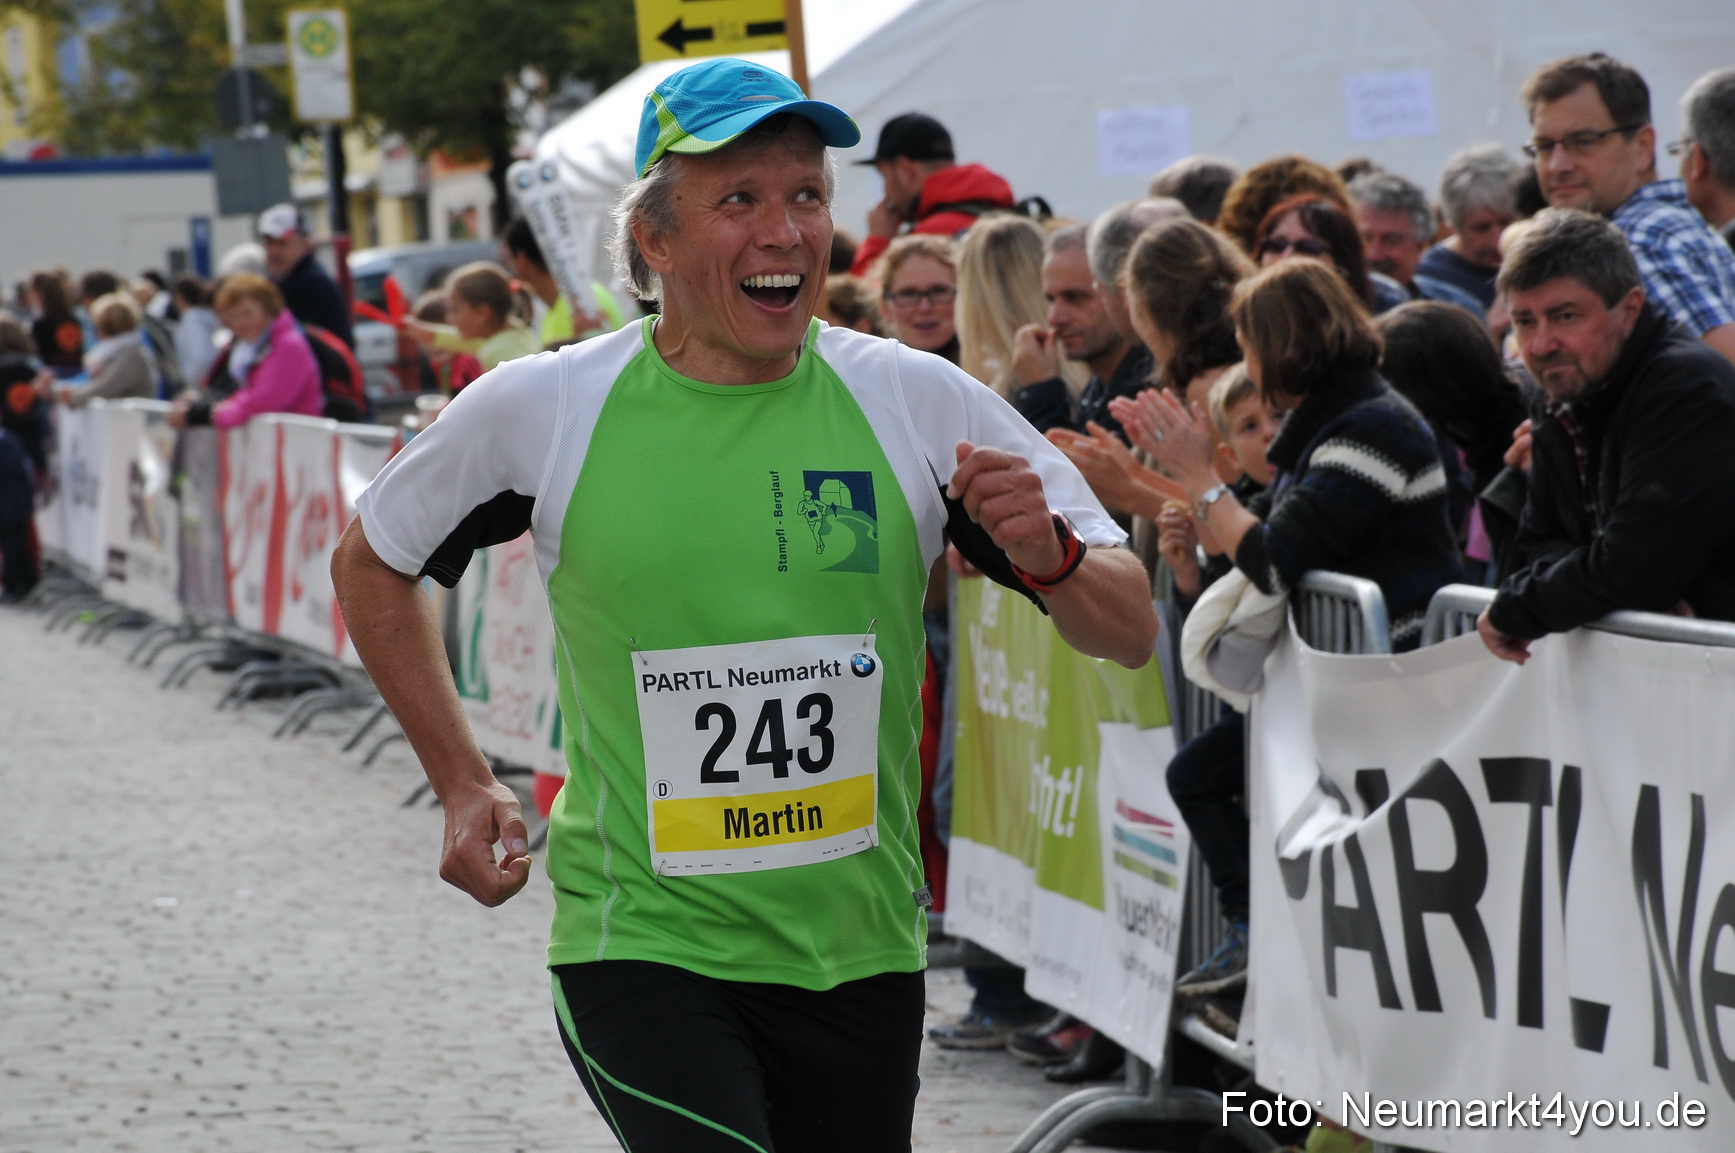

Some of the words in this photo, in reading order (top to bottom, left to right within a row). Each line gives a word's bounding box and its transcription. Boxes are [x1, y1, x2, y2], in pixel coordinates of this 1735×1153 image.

[769, 470, 784, 517] Berglauf
[775, 529, 788, 573] Stampfl
[642, 670, 722, 693] PARTL
[727, 659, 842, 688] Neumarkt
[695, 692, 835, 784] 243
[658, 782, 668, 797] D
[723, 801, 823, 840] Martin
